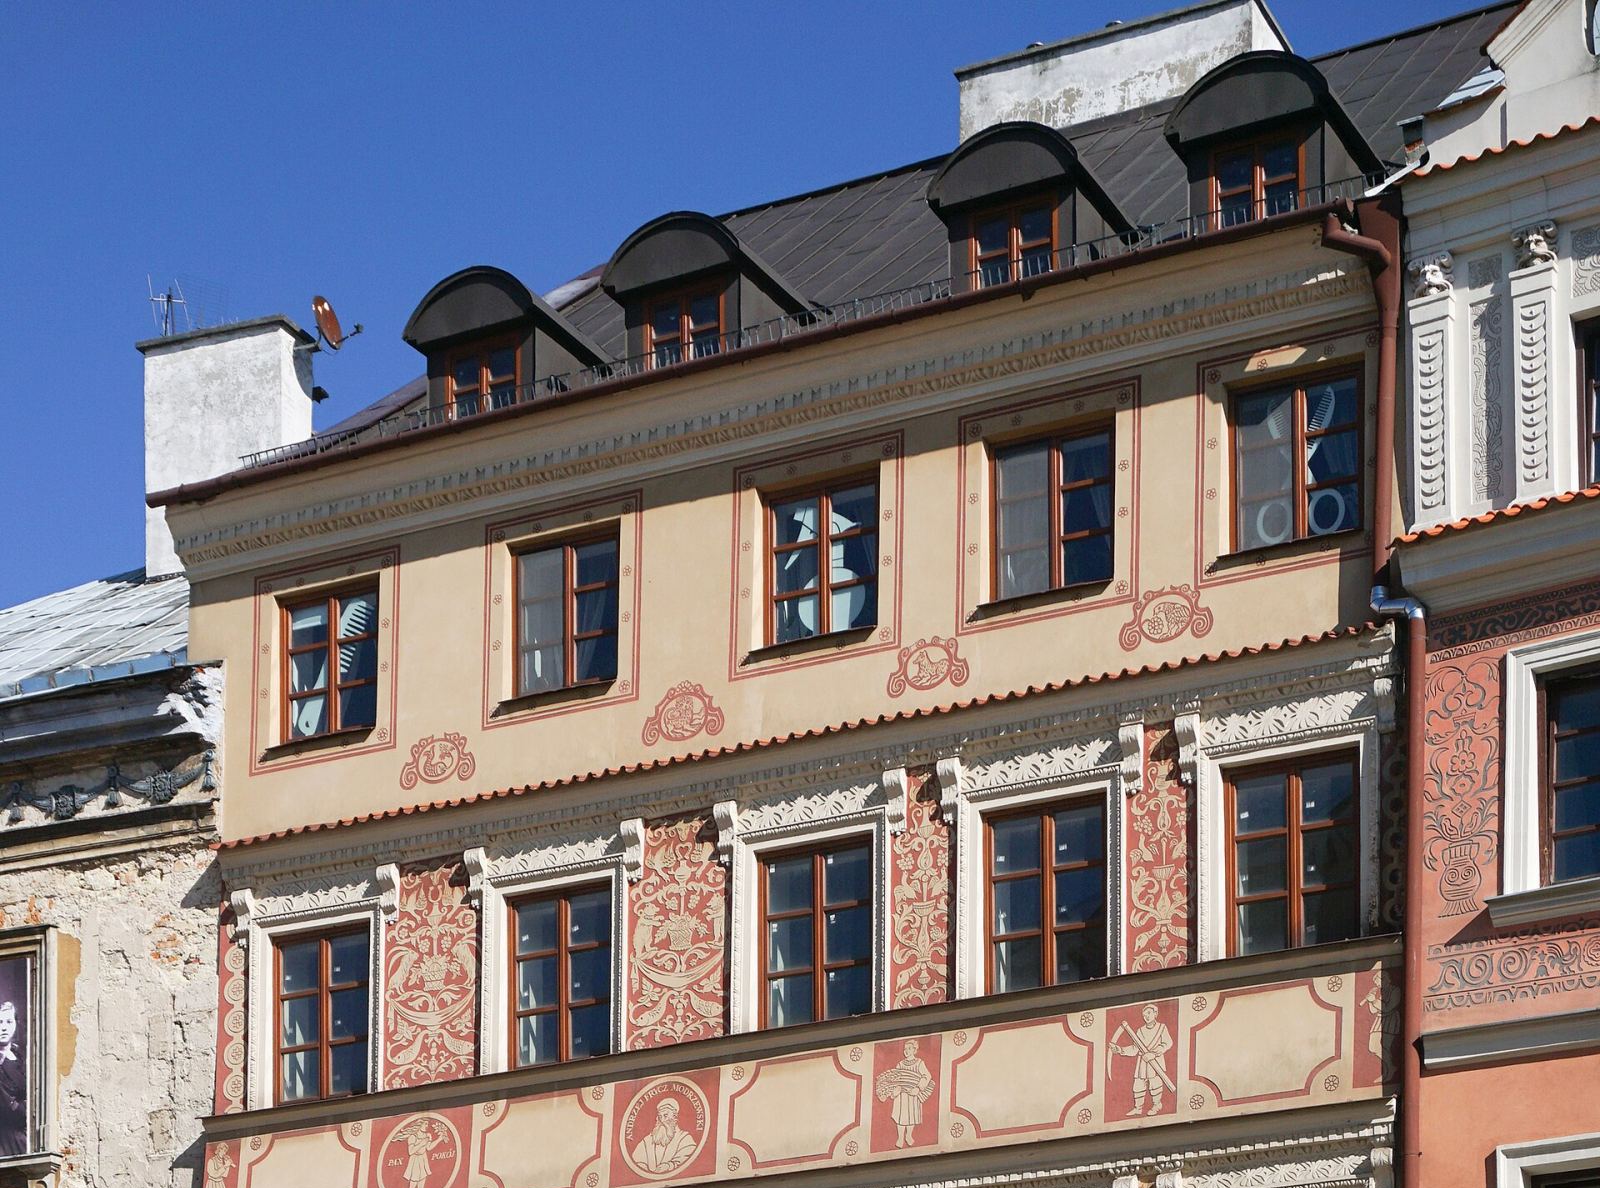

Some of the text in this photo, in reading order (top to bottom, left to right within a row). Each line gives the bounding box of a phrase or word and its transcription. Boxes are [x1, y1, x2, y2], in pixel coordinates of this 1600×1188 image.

[626, 1098, 645, 1141] ANDRZEJ
[671, 1083, 704, 1131] MODRZEWSKI
[431, 1148, 456, 1161] POKÓJ
[387, 1158, 404, 1167] PAX
